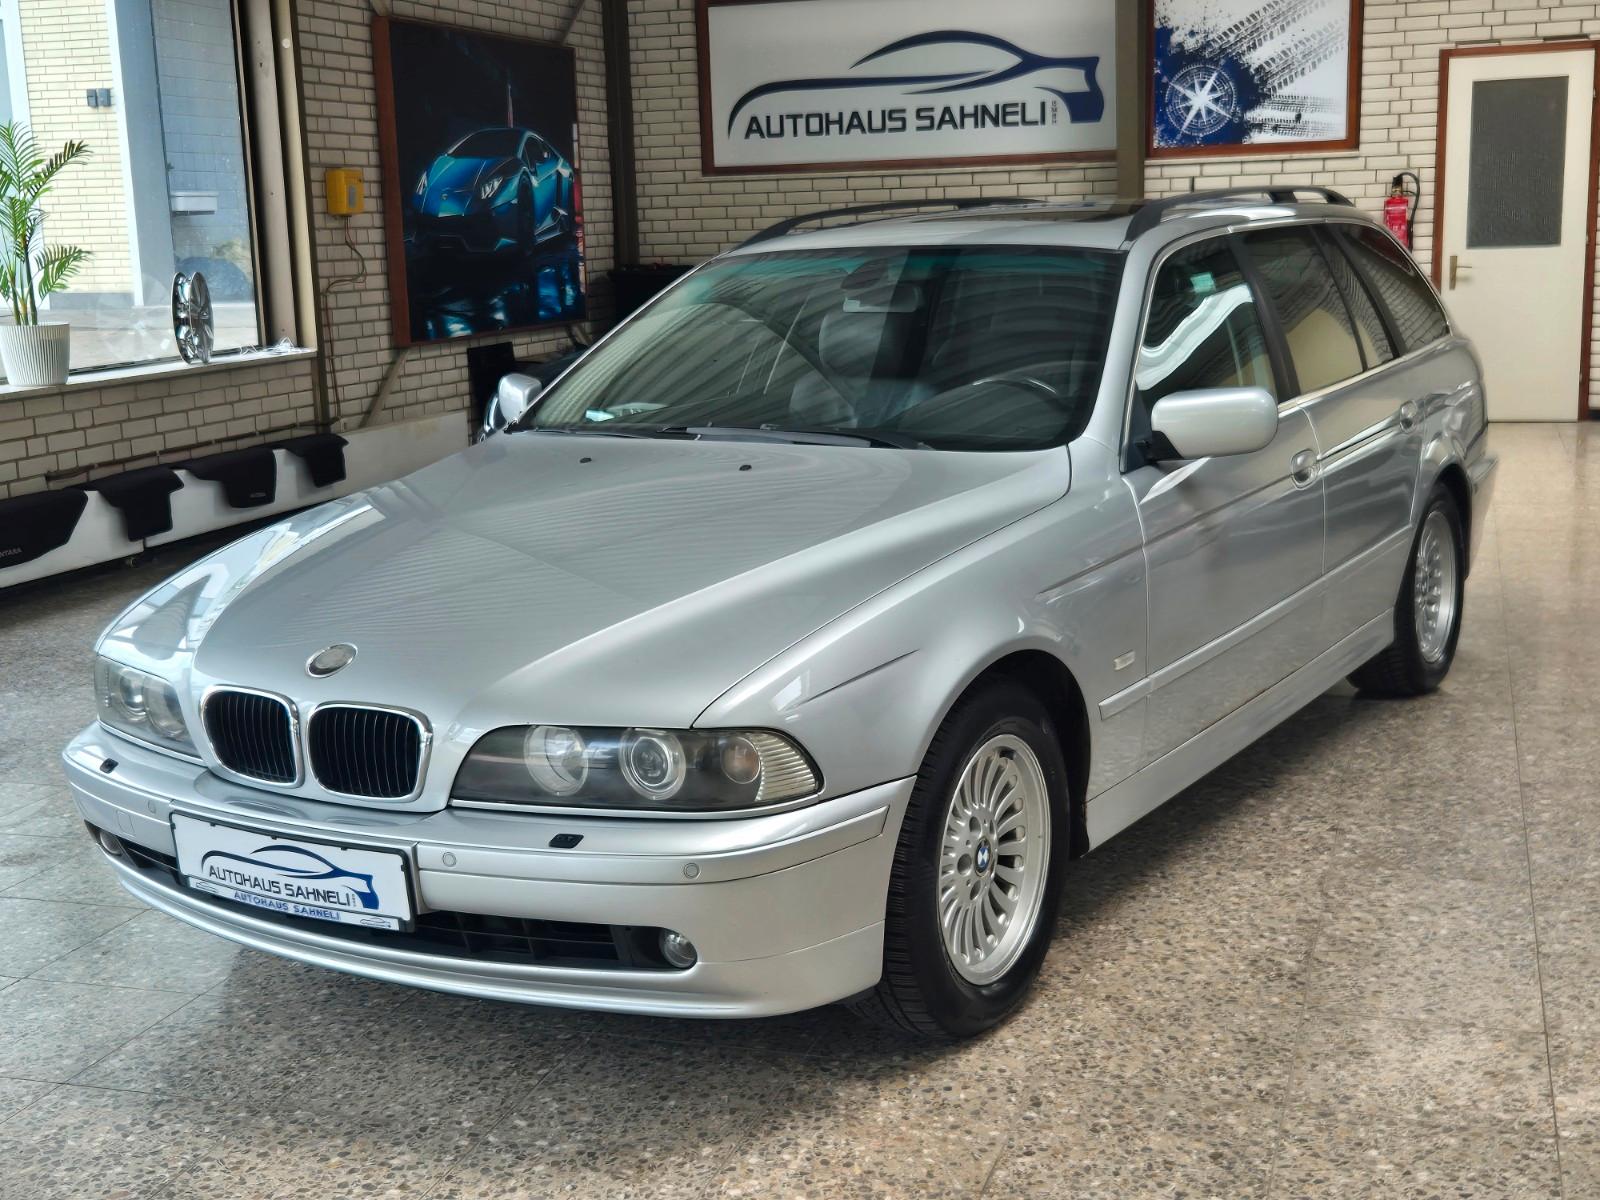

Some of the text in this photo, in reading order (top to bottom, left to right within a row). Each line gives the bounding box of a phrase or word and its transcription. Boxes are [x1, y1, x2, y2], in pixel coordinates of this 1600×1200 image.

[744, 101, 1047, 140] AUTOHAUS SAHNELI
[209, 865, 282, 894] AUTOHAUS
[284, 883, 351, 906] SAHNELI
[234, 890, 340, 921] AUTOHAUS SAHNELI
